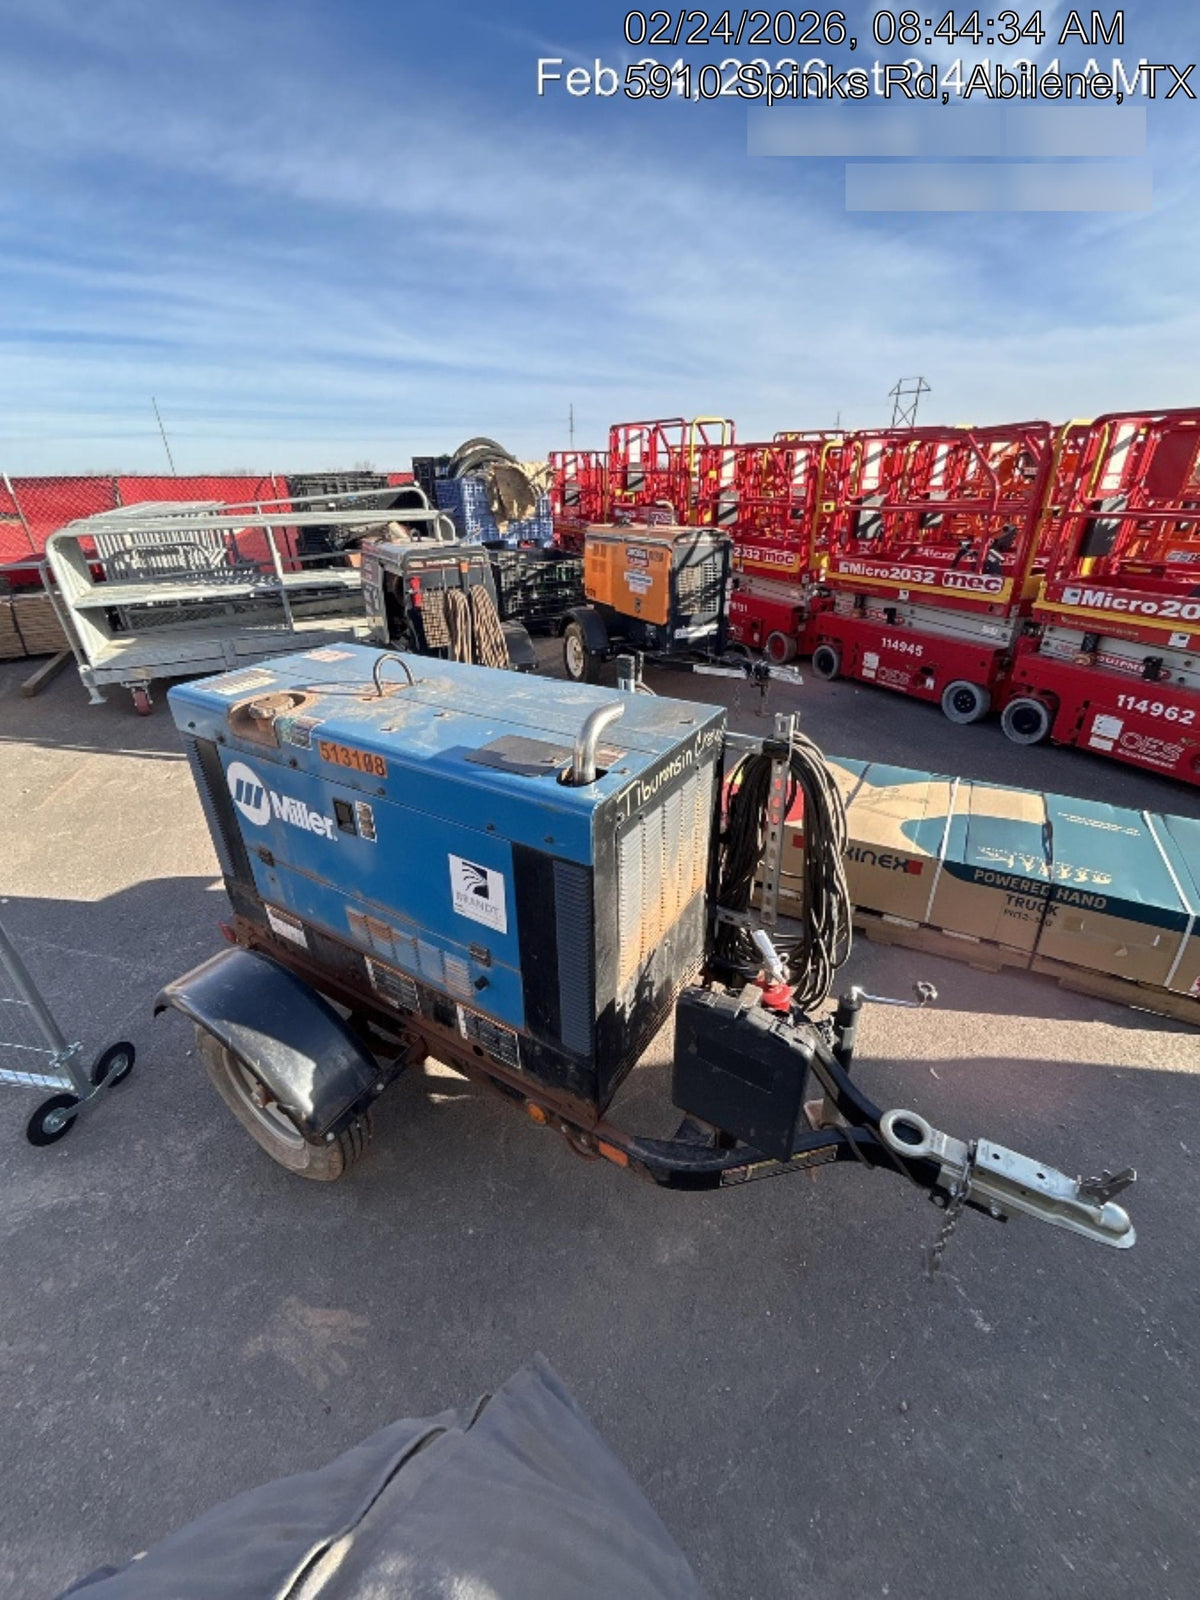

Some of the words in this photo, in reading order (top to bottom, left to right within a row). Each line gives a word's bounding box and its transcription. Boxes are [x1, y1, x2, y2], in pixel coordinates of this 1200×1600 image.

[848, 560, 936, 585] Micro2032
[942, 572, 1003, 594] mec
[1080, 588, 1200, 620] Micro20
[880, 637, 925, 658] 114945
[1117, 693, 1196, 726] 114962
[318, 741, 387, 777] 513108
[1005, 893, 1061, 918] TRUCK
[1055, 888, 1108, 911] HAND
